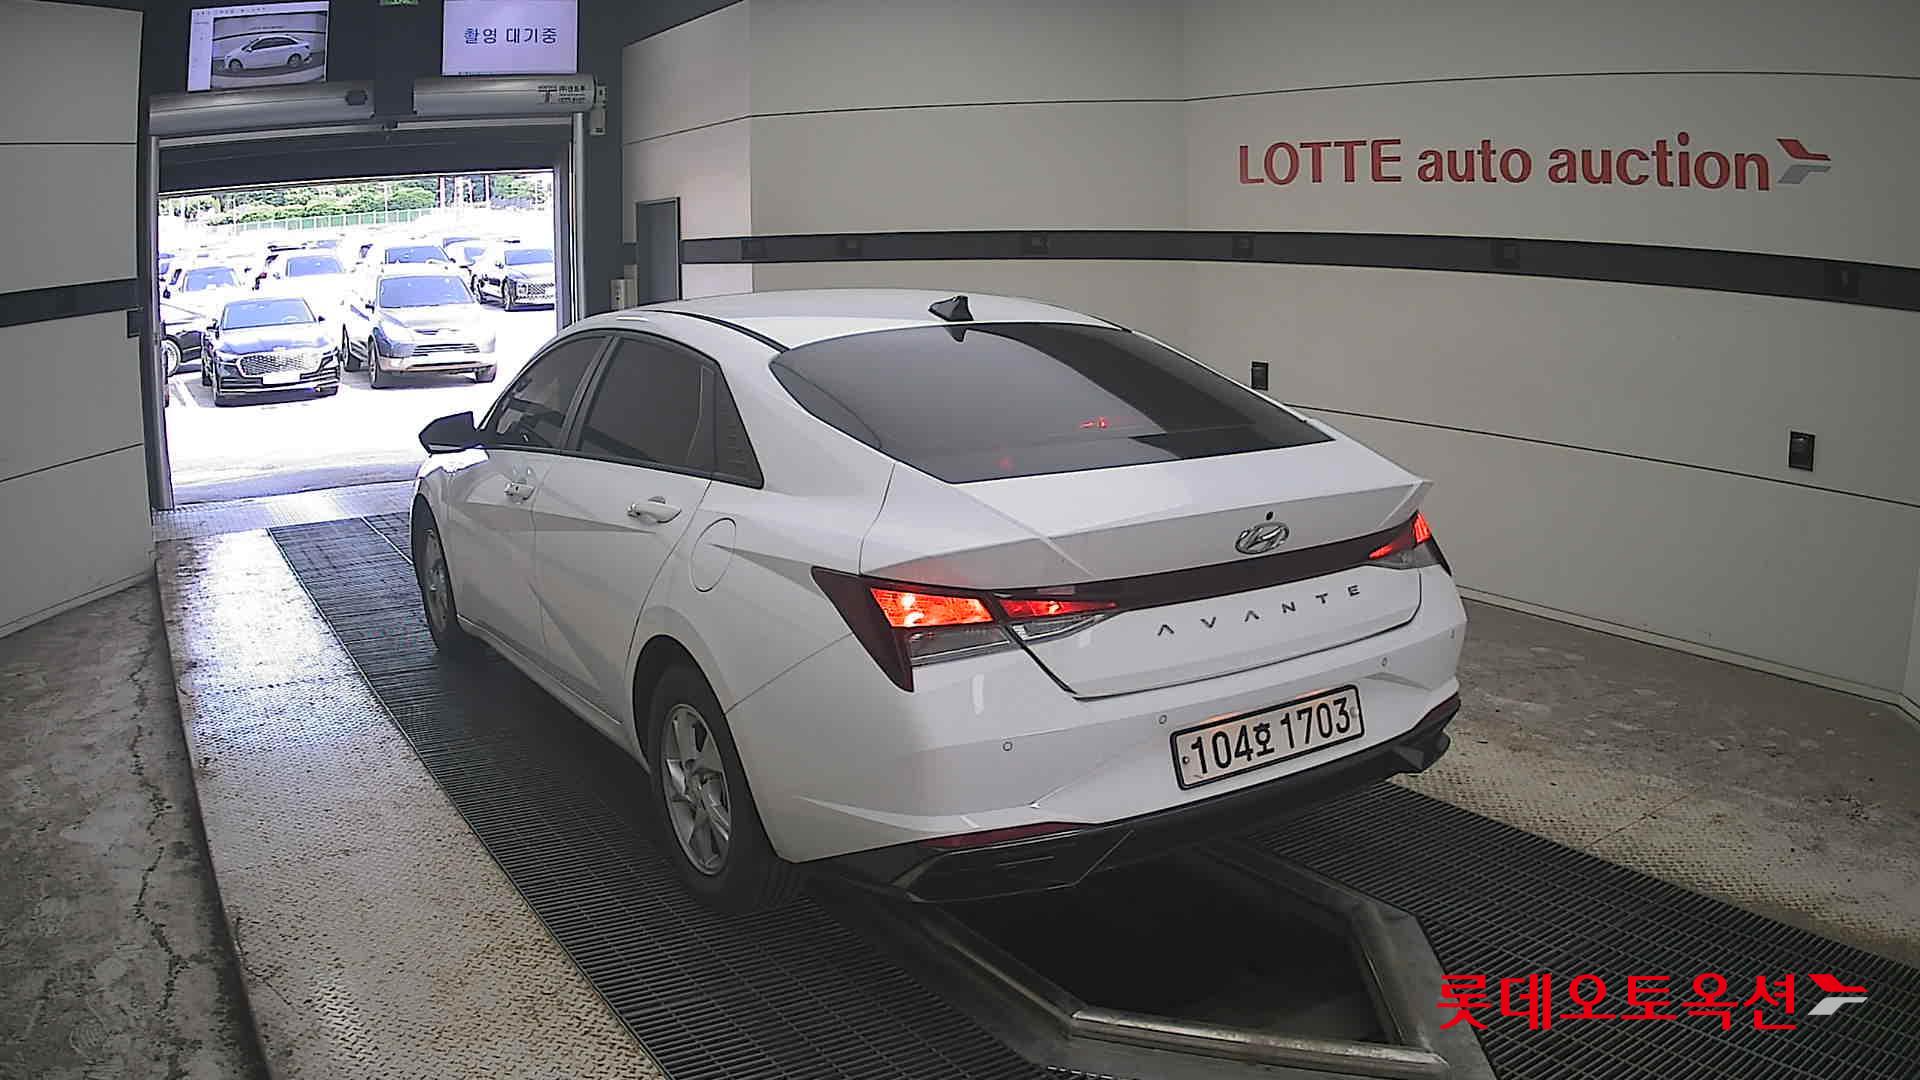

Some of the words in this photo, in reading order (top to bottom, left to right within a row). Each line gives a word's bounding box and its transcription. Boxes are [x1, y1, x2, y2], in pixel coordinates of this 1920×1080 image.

[464, 27, 497, 44] 촬영
[506, 27, 557, 44] 대기중
[1240, 139, 1401, 185] LOTTE
[1417, 139, 1532, 183] auto
[1548, 131, 1770, 191] auction
[1157, 584, 1361, 636] AVANTE
[1280, 697, 1351, 749] 1703
